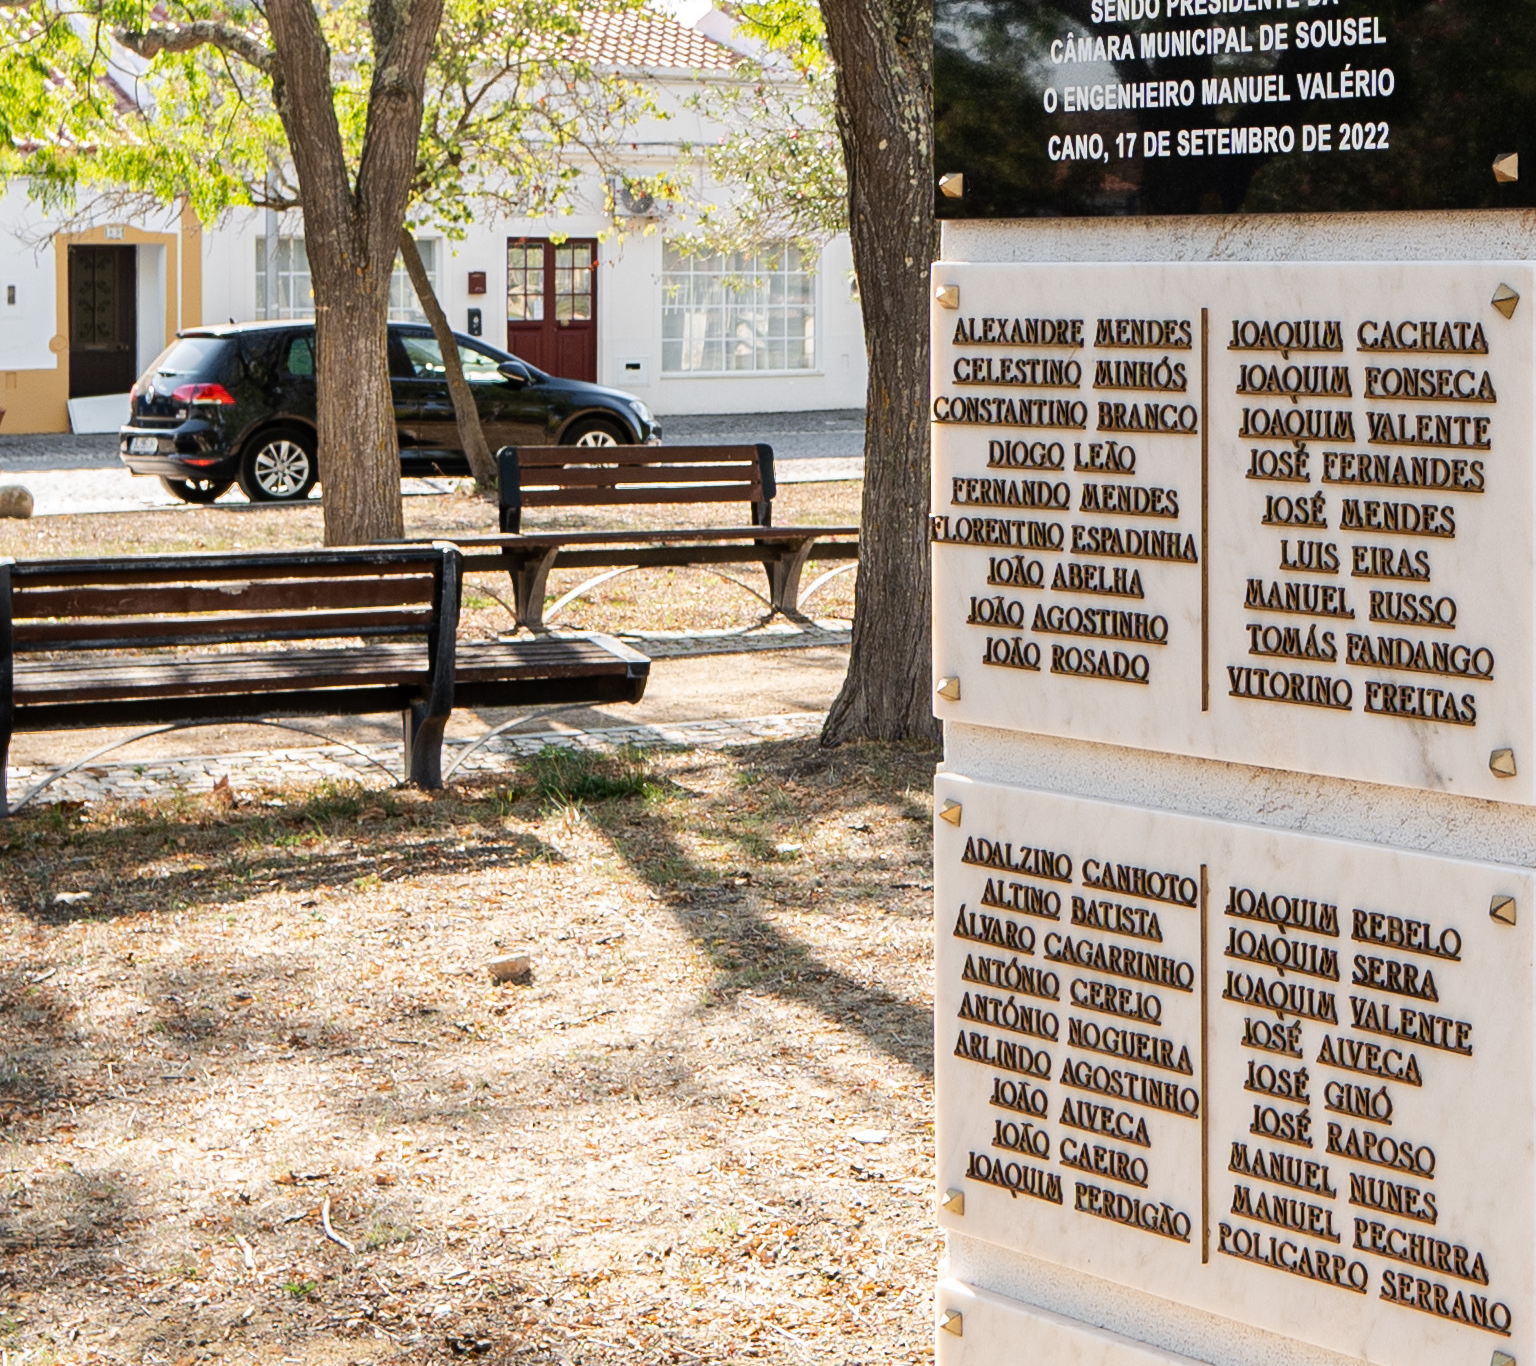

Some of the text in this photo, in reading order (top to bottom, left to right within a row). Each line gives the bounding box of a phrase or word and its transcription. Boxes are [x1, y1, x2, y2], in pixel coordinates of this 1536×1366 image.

[1050, 17, 1386, 64] CÂMARA MUNICIPAL DE SOUSEL
[1043, 64, 1394, 114] O ENGENHEIRO MANUEL VALÉRIO
[1049, 122, 1389, 163] CANO, 17 DE SETEMBRO DE 2022
[953, 318, 1192, 349] ALEXANDRE MENDES
[1227, 320, 1489, 360] JOAQUIM CACHATA
[953, 356, 1187, 392] CELESTINO MINHÓS
[1236, 365, 1497, 404] JOAQUIM FONSECA
[931, 397, 1197, 434] CONSTANTINO BRANCO
[987, 440, 1136, 475] DIOGO LEÃO
[1227, 666, 1476, 726] VITORINO FREITAS
[961, 836, 1197, 908] ADALZINO CANHOTO
[981, 878, 1163, 943] ALTINO BATISTA
[1224, 887, 1461, 961] JOAQUIM REBELO
[953, 904, 1194, 993] ÁLVARO CAGARRINHO
[1228, 1142, 1438, 1225] MANUEL NUNES
[1231, 1185, 1489, 1286] MANUEL PECHIRRA
[1218, 1223, 1511, 1337] POLICARPO SERRANO
